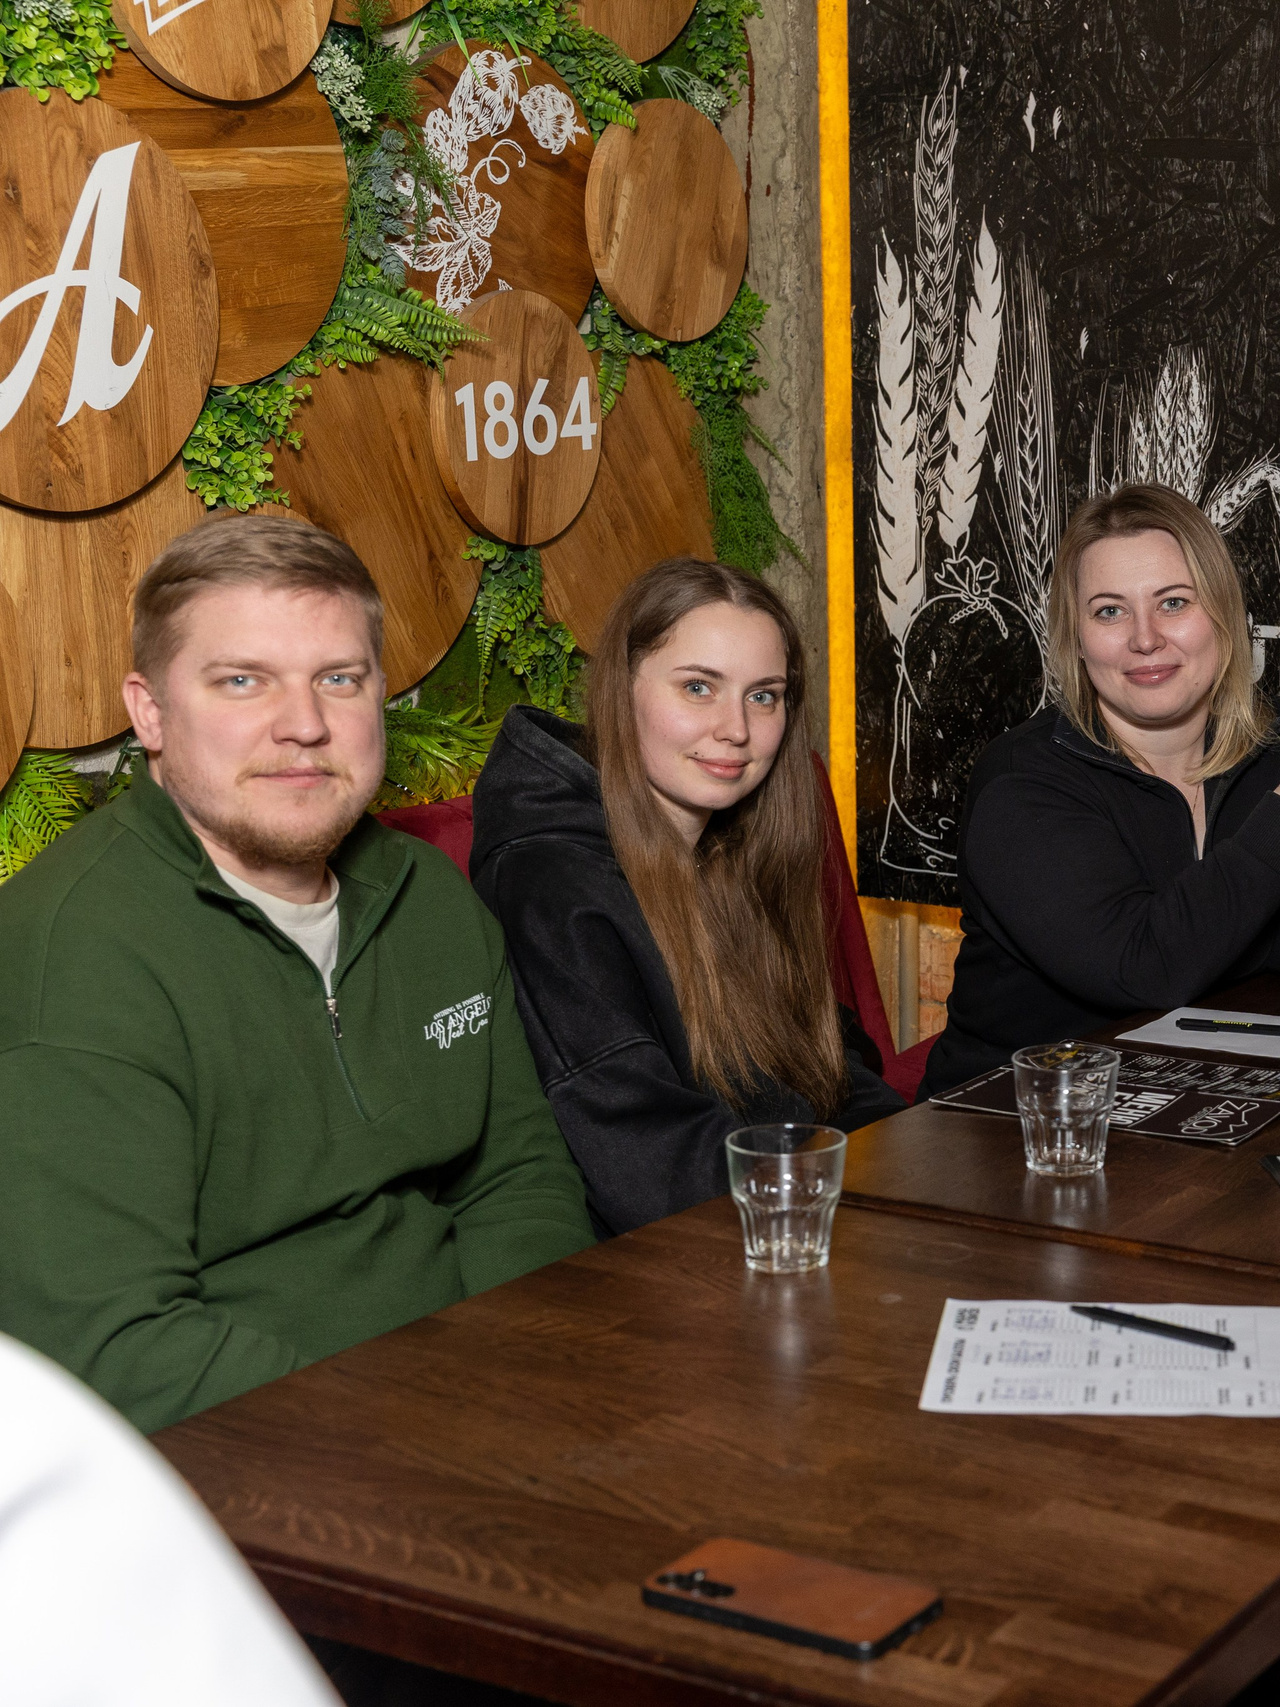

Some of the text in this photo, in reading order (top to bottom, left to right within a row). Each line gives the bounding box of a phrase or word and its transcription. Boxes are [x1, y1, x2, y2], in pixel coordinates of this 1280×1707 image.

[455, 376, 598, 462] 1864
[424, 1018, 445, 1040] LOS
[1181, 1100, 1249, 1135] ZAVOD
